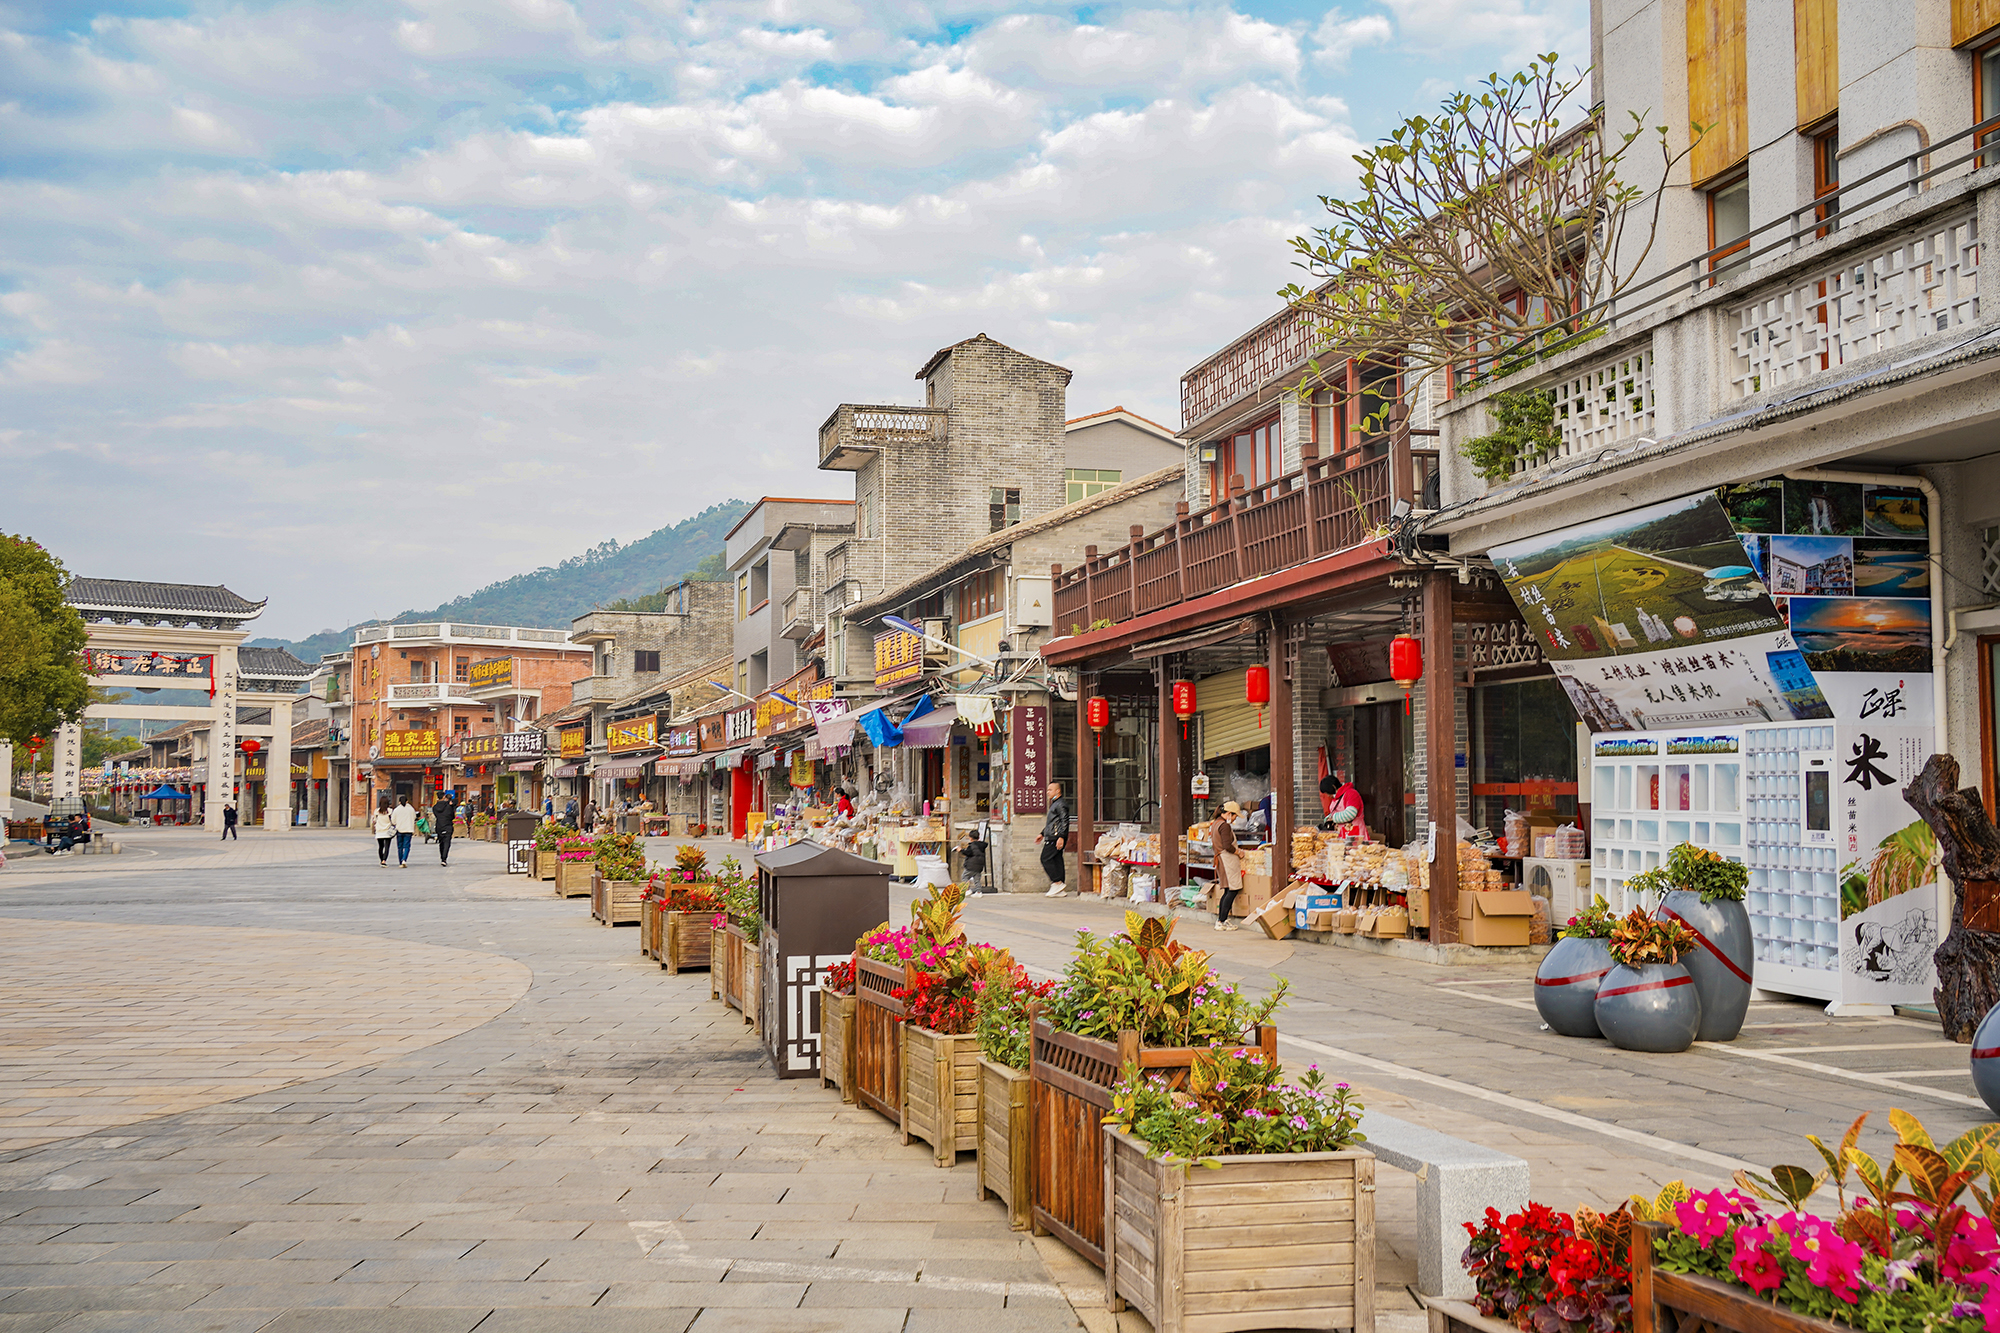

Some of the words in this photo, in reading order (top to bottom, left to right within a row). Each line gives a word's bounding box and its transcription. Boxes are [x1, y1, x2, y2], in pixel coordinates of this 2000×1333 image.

[370, 666, 380, 742] 水上人家
[1644, 681, 1721, 704] 无人售米机
[1859, 687, 1907, 720] 正果
[385, 730, 438, 747] 渔家菜
[1335, 717, 1346, 783] 欢迎光临
[1843, 733, 1898, 791] 米
[1847, 797, 1858, 834] 丝苗米
